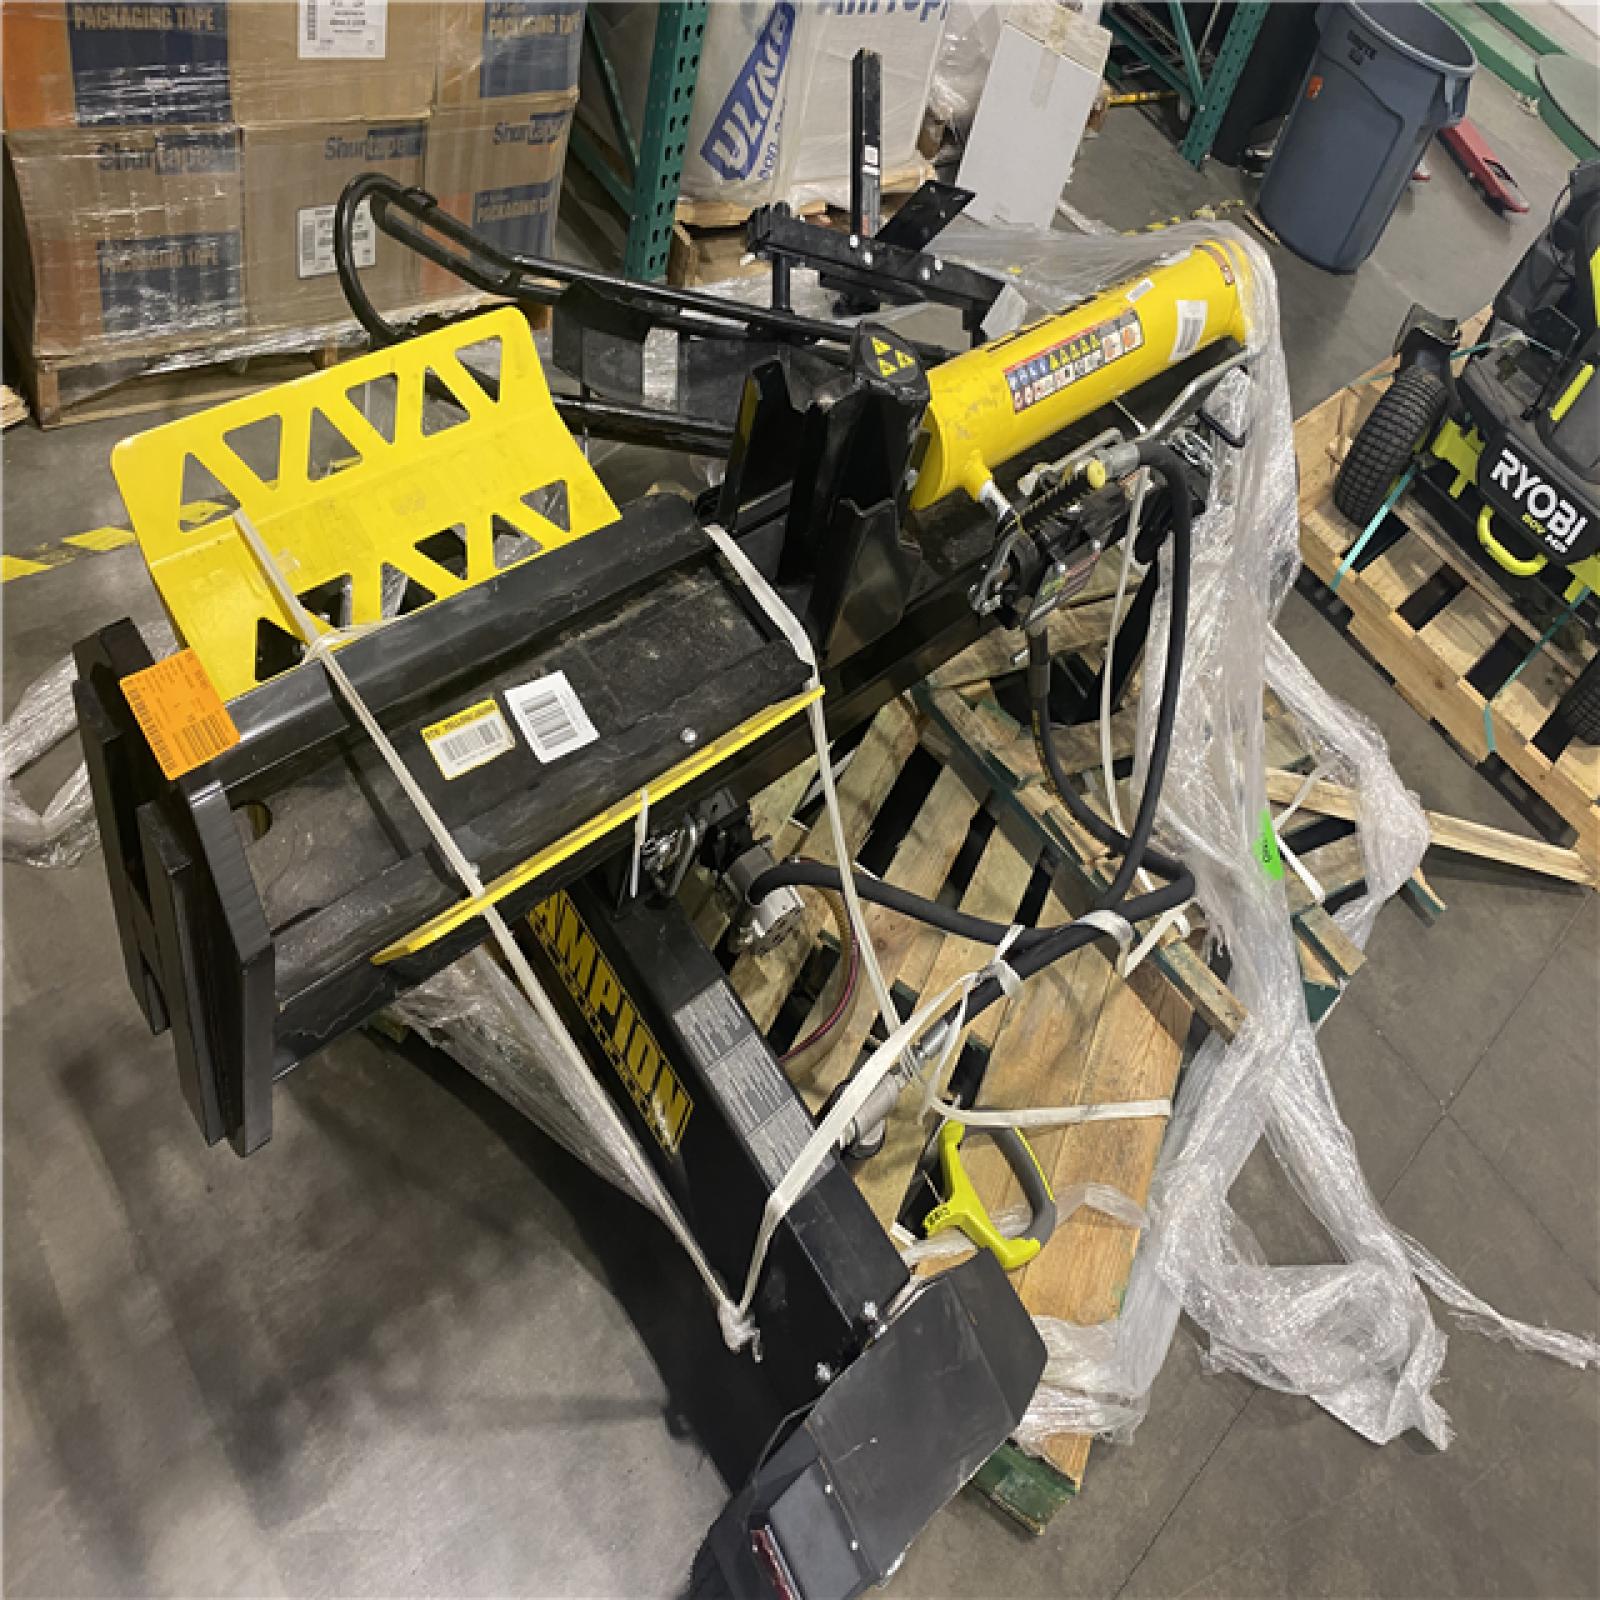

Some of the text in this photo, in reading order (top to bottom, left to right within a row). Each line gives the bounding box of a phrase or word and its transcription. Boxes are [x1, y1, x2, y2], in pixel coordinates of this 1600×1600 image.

[74, 7, 215, 31] PACKAGING TAPE
[1490, 448, 1588, 546] RYOBI
